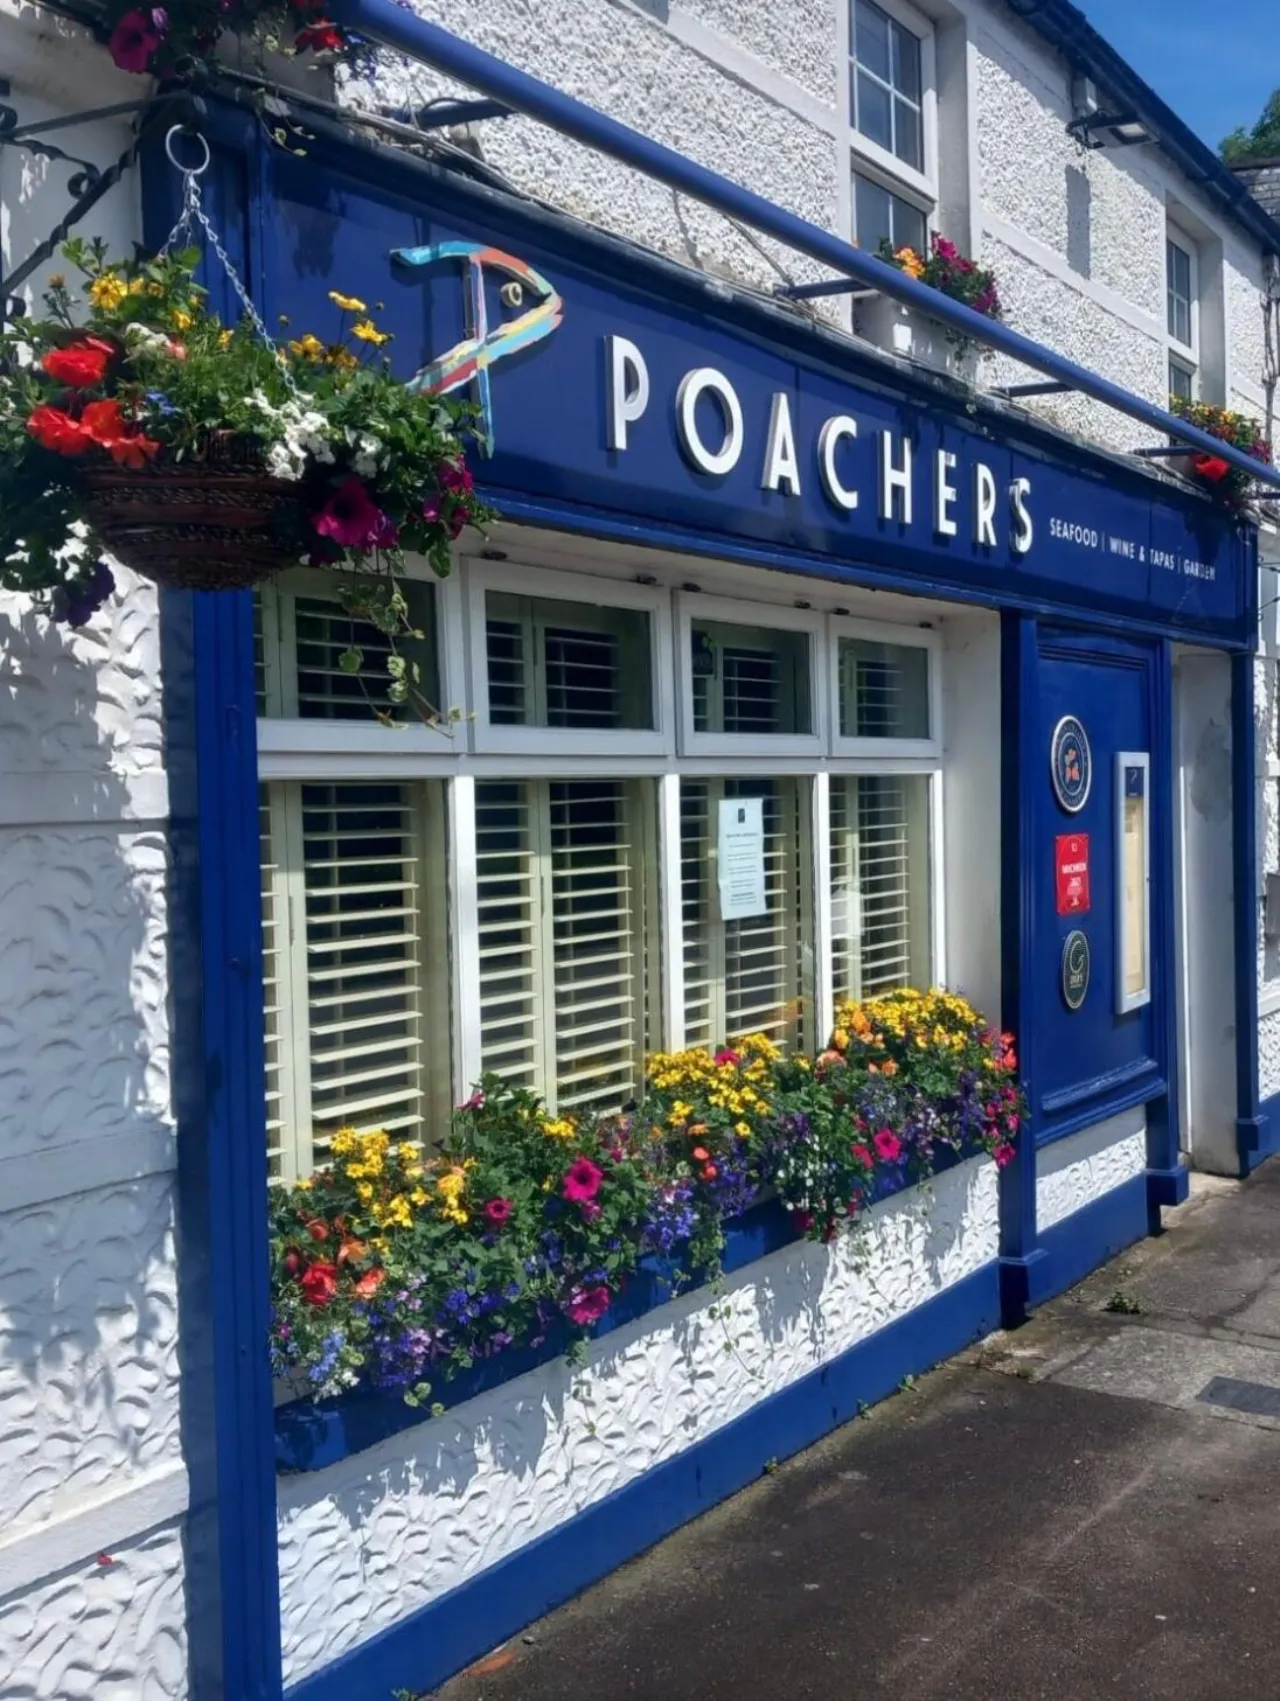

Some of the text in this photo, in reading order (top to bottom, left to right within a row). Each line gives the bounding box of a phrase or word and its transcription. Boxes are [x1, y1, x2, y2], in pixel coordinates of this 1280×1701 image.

[605, 335, 1033, 554] POACHERS
[1050, 517, 1216, 581] SEAFOOD WINE & TAPAS GARDEN
